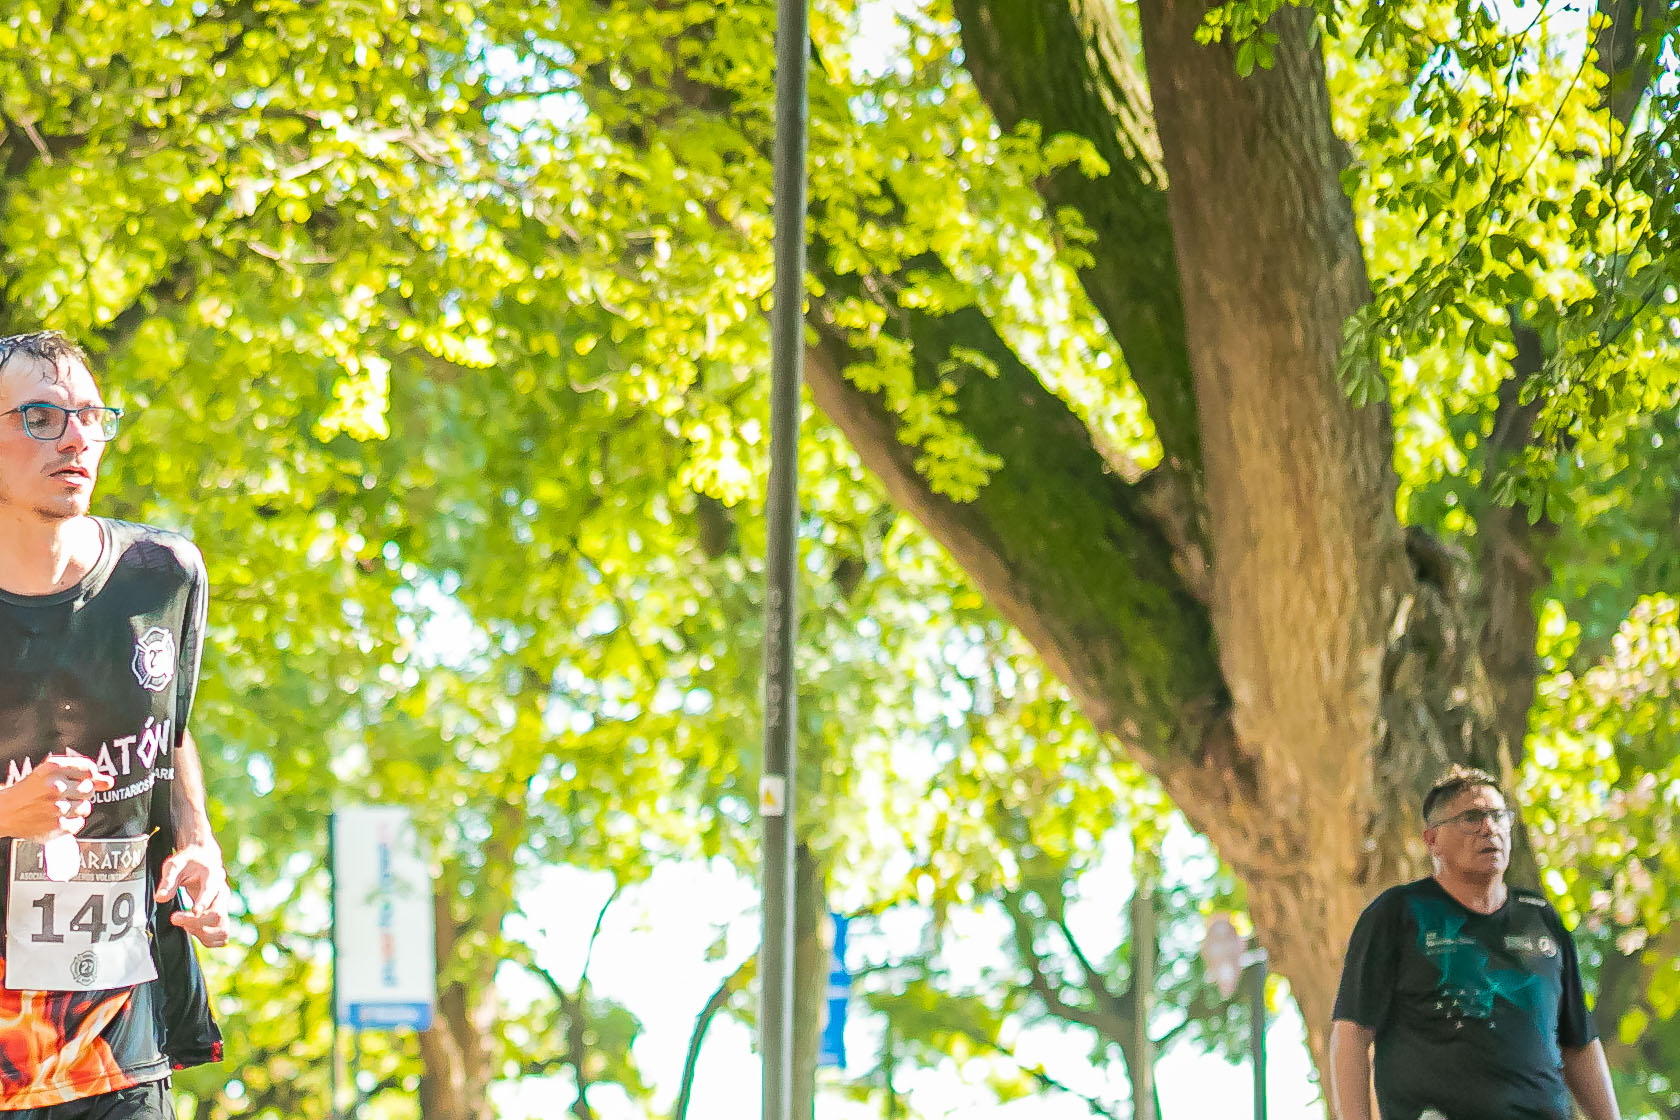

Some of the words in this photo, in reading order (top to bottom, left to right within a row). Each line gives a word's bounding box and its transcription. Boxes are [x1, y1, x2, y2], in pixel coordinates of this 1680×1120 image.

[5, 716, 171, 786] MATÓN
[90, 778, 150, 804] OLUNTARIOS
[78, 845, 141, 869] ARATÓN
[31, 892, 135, 944] 149
